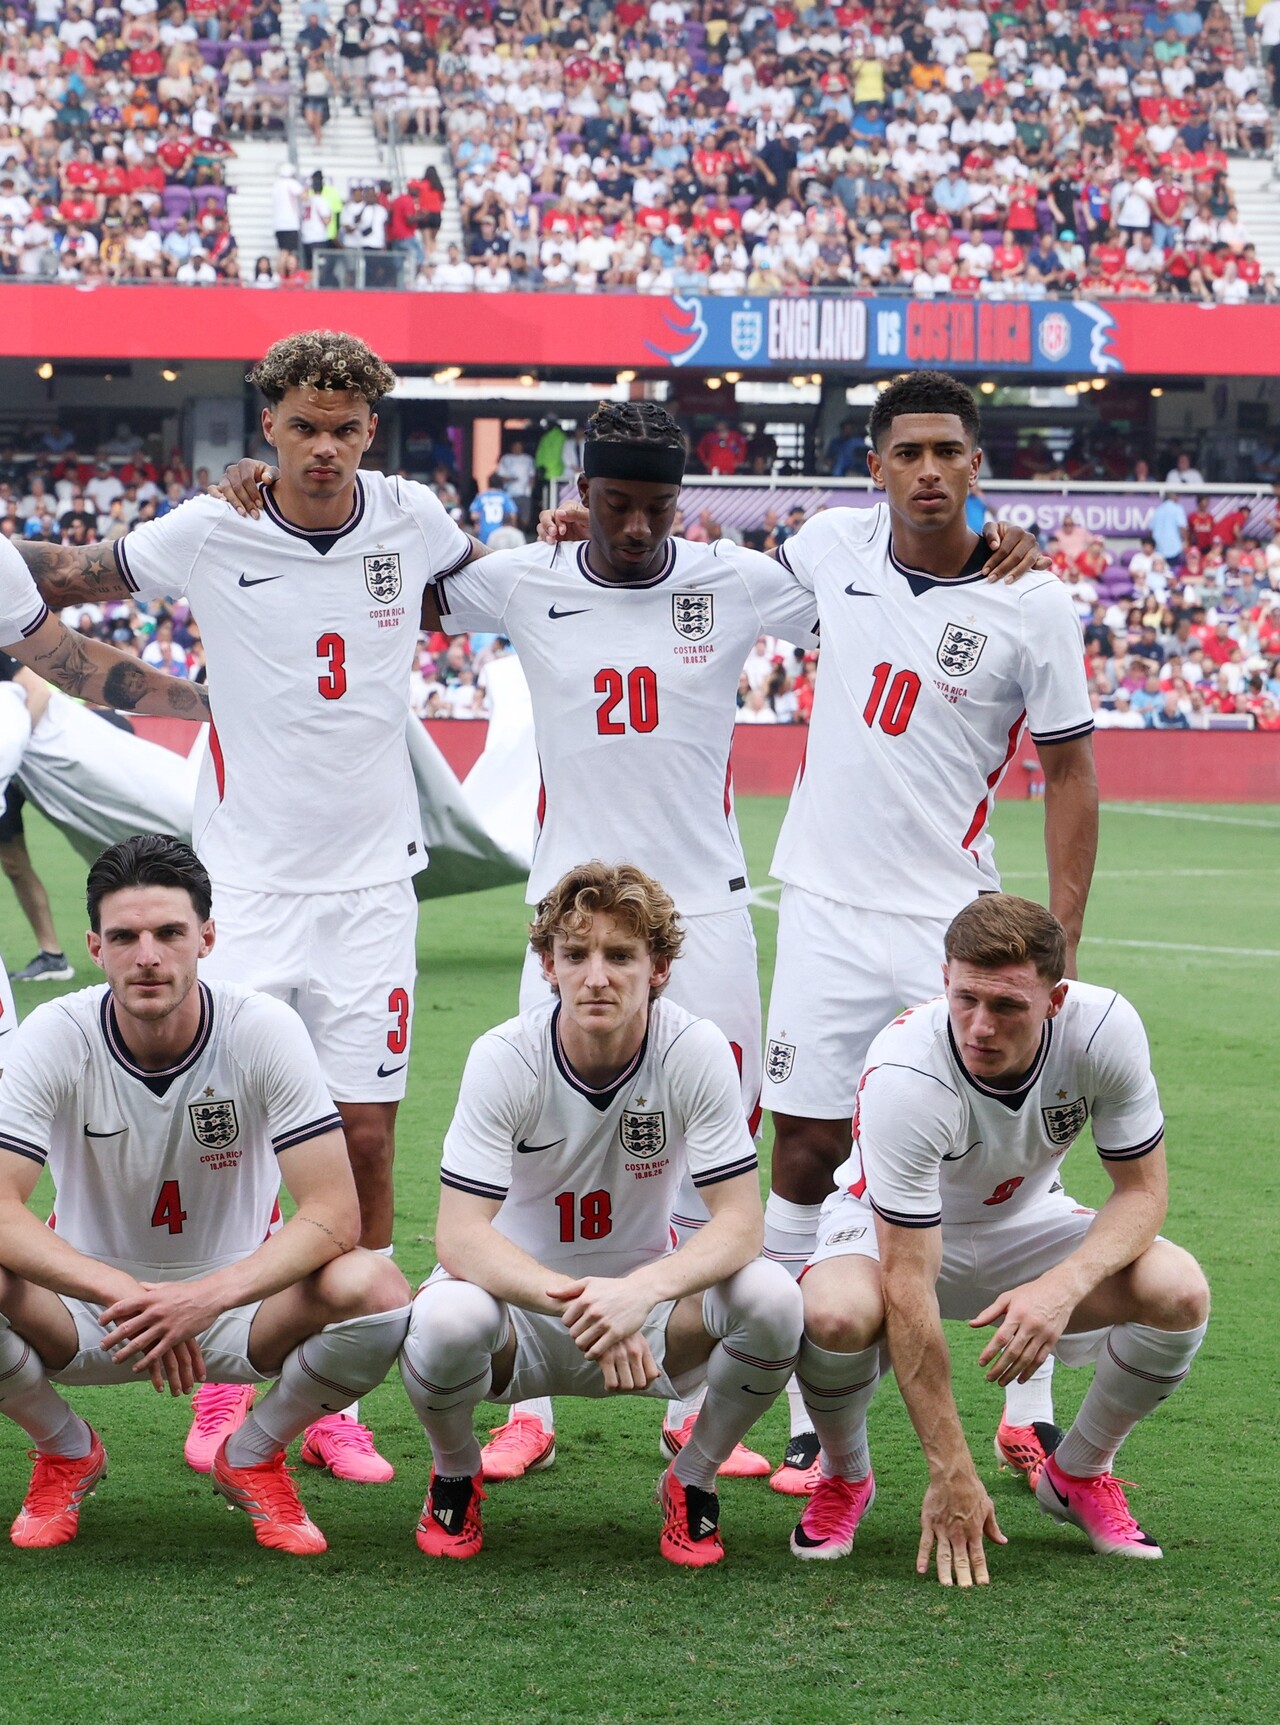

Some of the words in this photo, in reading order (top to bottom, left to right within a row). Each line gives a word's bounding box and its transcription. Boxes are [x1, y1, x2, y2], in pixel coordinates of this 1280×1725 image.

[767, 298, 867, 361] ENGLAND
[877, 310, 901, 356] VS
[906, 301, 975, 361] COSTA
[977, 302, 1032, 363] RICA
[369, 609, 391, 619] COSTA
[391, 607, 406, 617] RICA
[316, 632, 347, 700] 3
[673, 645, 697, 655] COSTA
[698, 644, 714, 654] RICA
[593, 666, 659, 735] 20
[862, 661, 922, 737] 10
[950, 686, 968, 697] RICA
[386, 987, 409, 1055] 3
[200, 1153, 225, 1163] COSTA
[624, 1163, 651, 1172] COSTA
[652, 1158, 670, 1169] RICA
[151, 1179, 188, 1235] 4
[554, 1188, 613, 1243] 18
